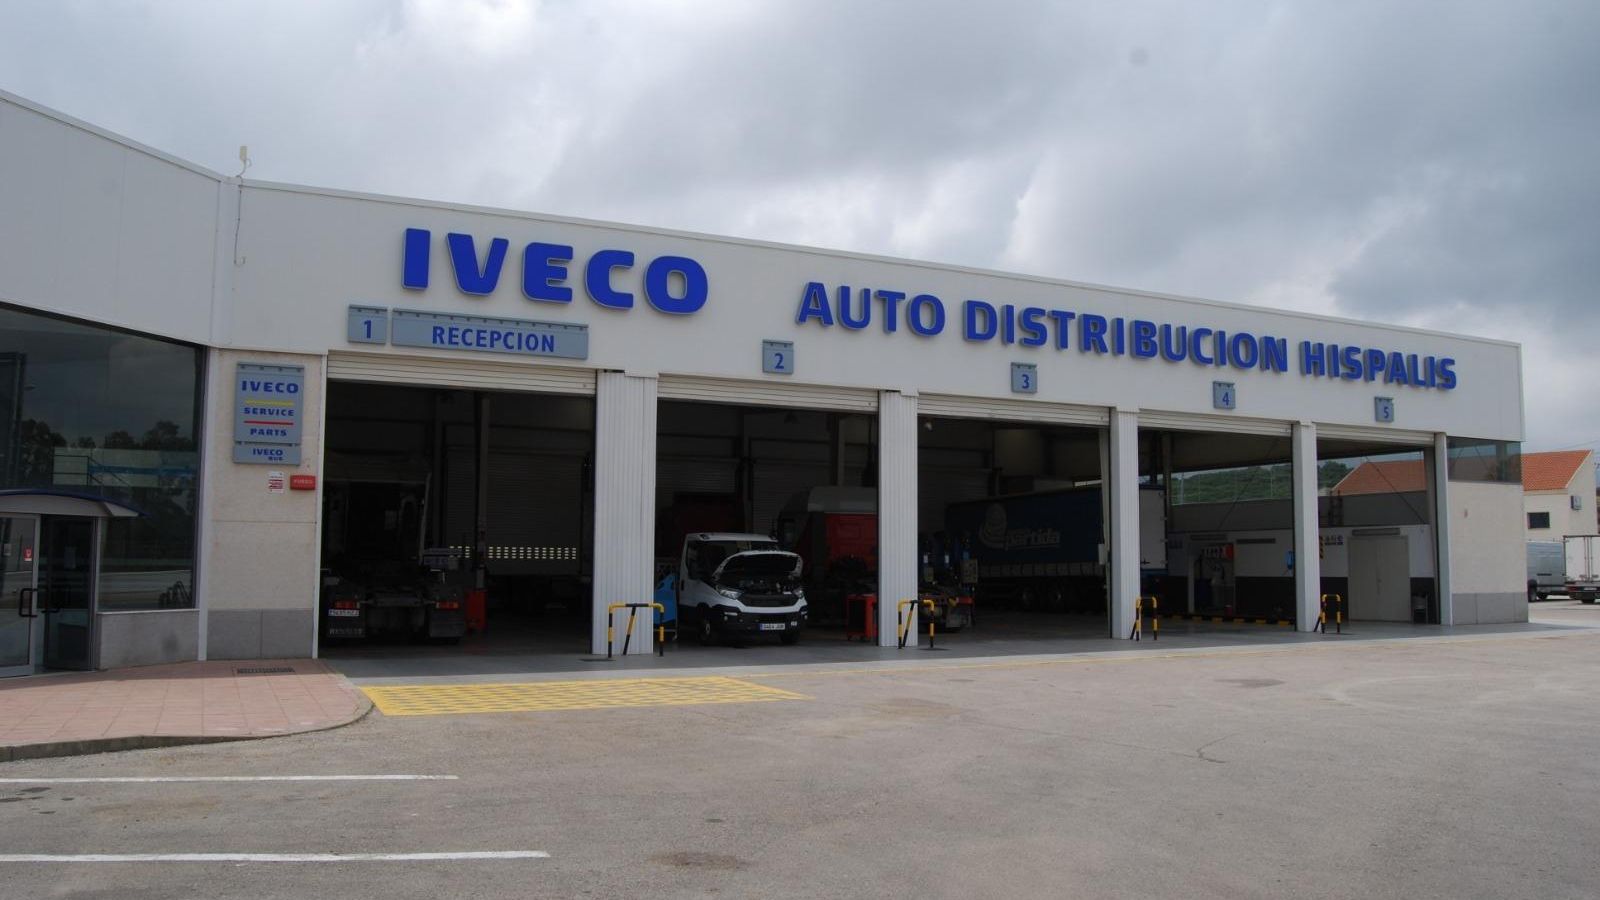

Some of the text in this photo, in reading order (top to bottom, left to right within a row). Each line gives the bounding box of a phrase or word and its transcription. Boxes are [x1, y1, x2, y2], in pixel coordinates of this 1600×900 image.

[402, 228, 709, 314] IVECO
[363, 320, 372, 339] 1
[797, 281, 1457, 390] AUTO DISTRIBUCION HISPALIS
[431, 325, 556, 353] RECEPCION
[773, 353, 785, 370] 2
[241, 381, 298, 393] IVECO
[1021, 373, 1031, 389] 3
[1221, 392, 1231, 406] 4
[244, 407, 294, 416] SERVICE
[1383, 405, 1391, 419] 5
[250, 428, 287, 436] PARTS
[253, 448, 283, 456] IVECO
